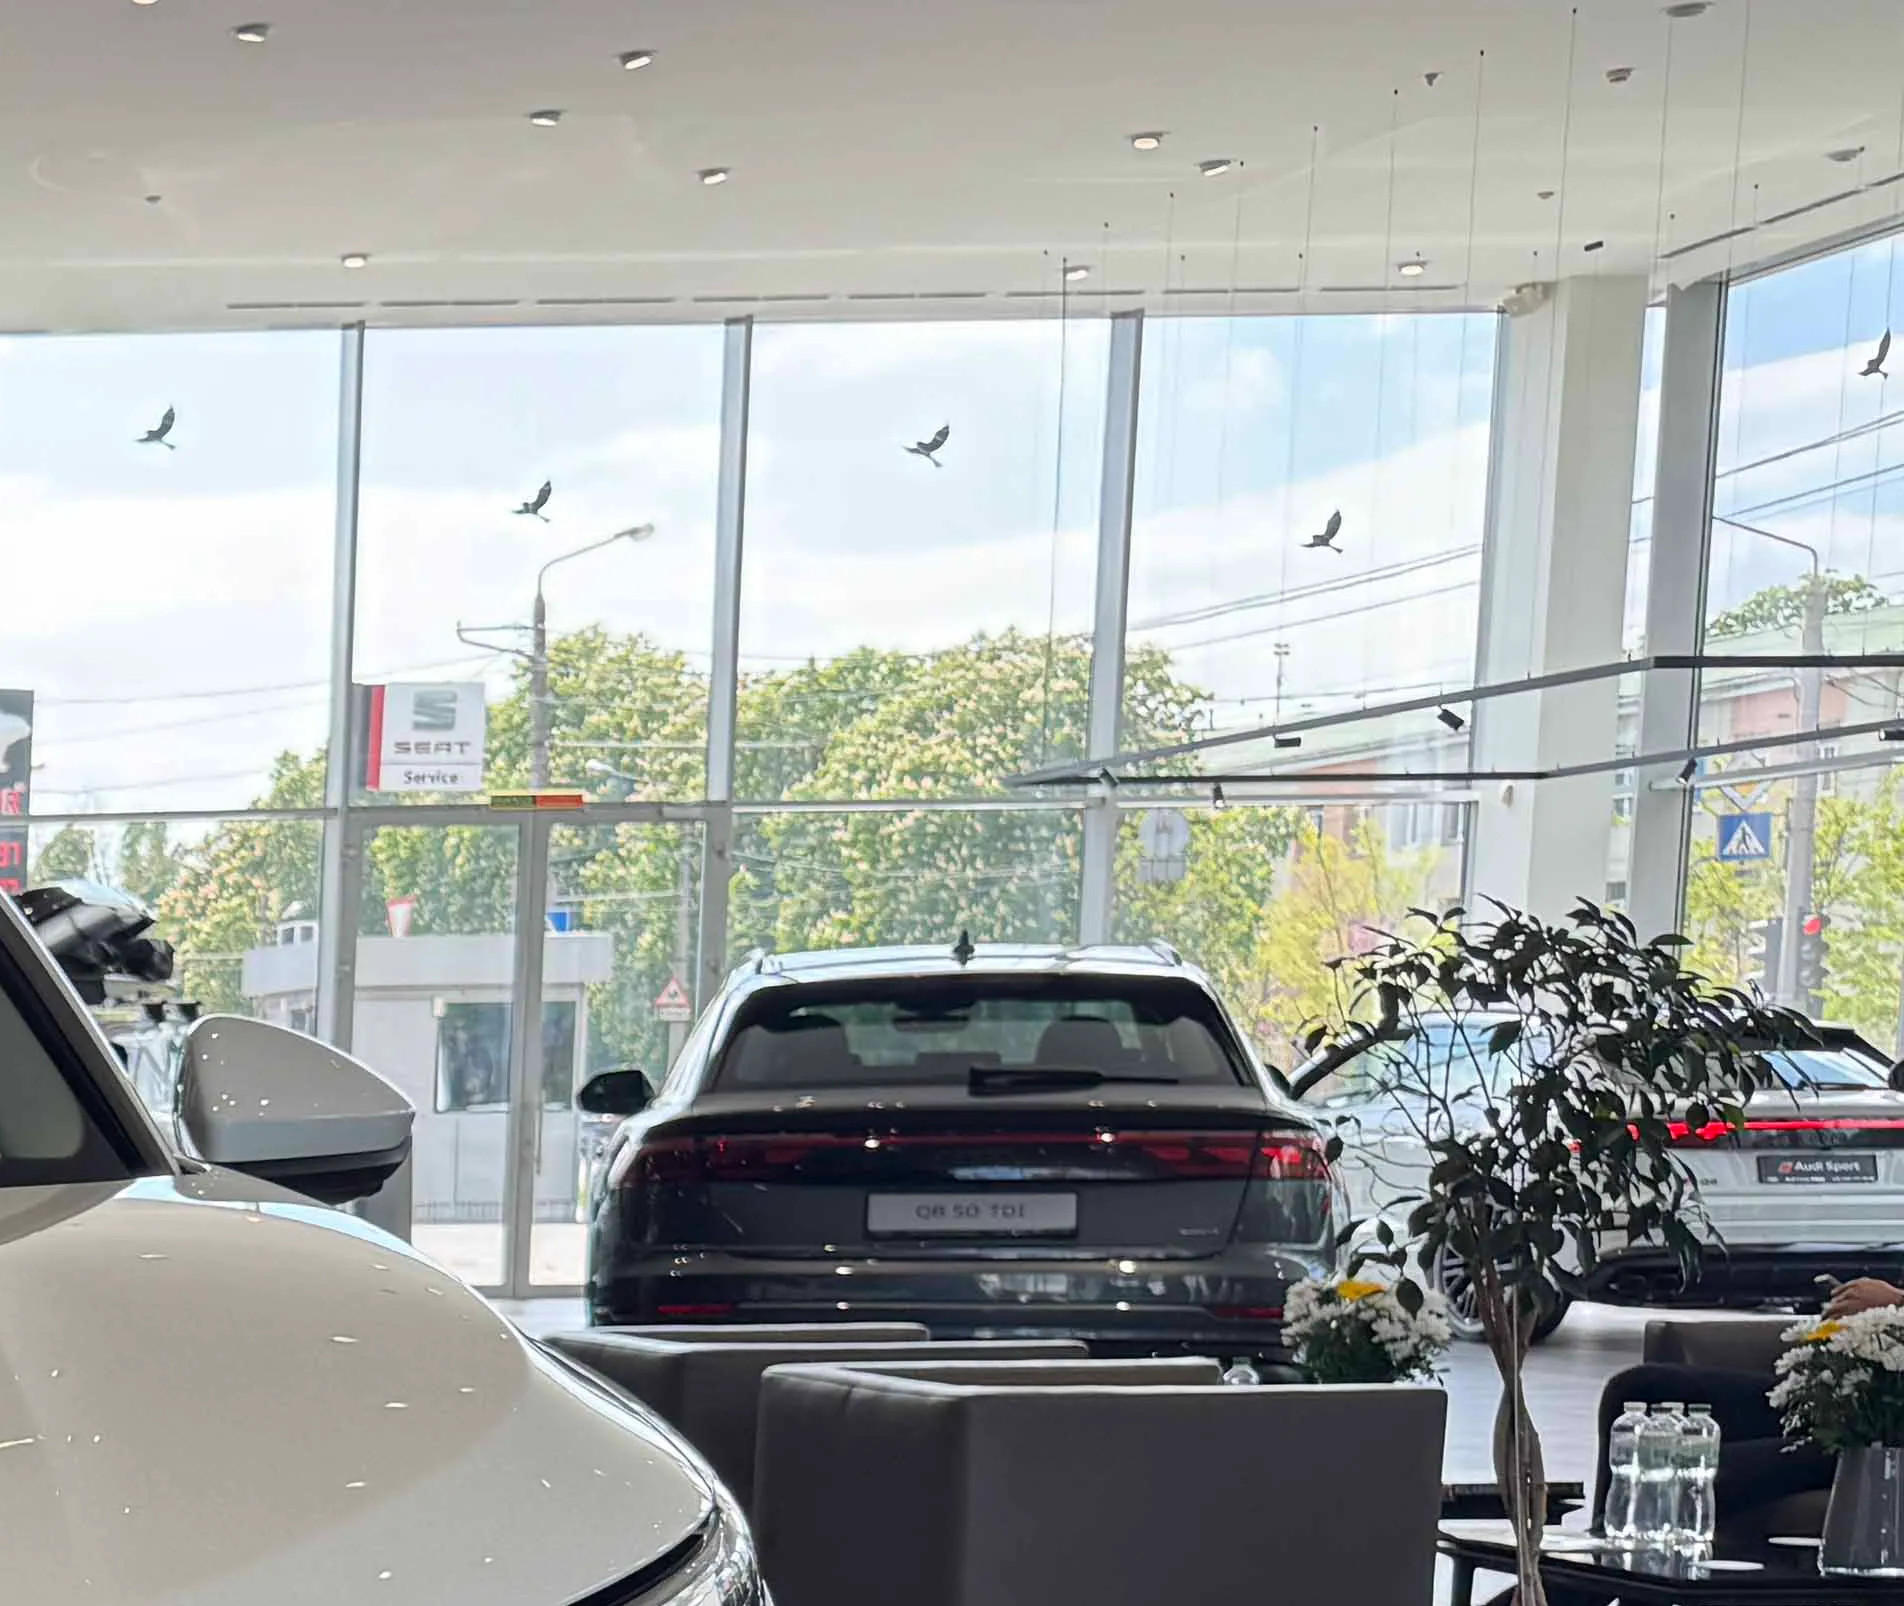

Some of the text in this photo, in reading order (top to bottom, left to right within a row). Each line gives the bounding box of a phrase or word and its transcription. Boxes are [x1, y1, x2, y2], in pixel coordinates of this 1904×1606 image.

[394, 741, 471, 755] SEAT
[403, 769, 459, 785] Service
[1793, 1160, 1824, 1172] Audi
[952, 1203, 980, 1219] 50
